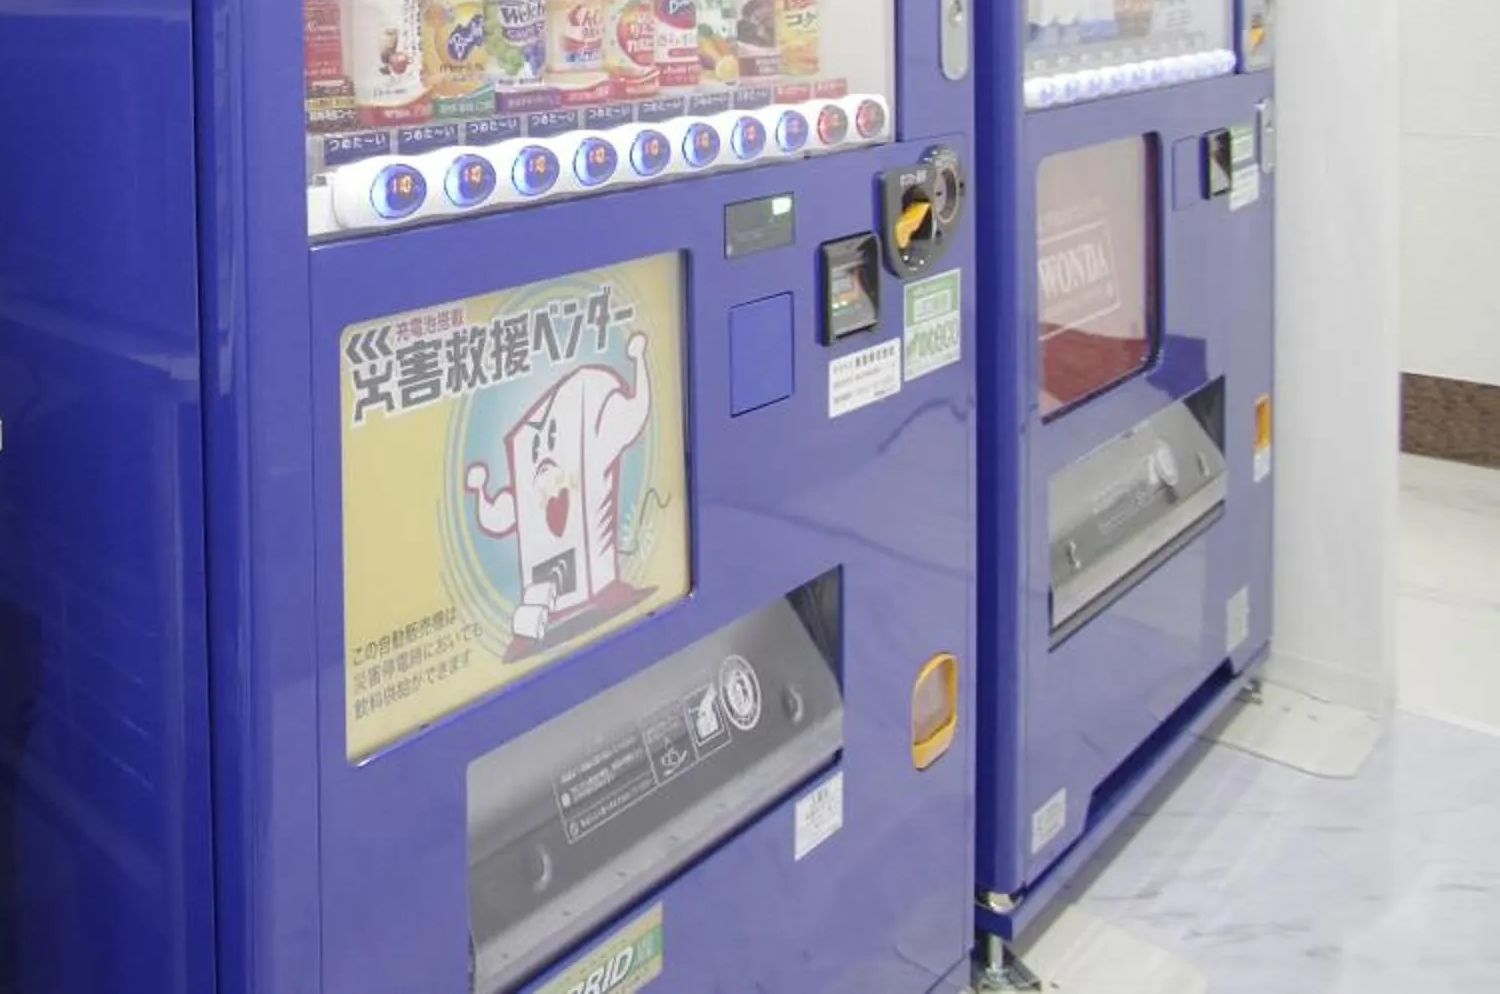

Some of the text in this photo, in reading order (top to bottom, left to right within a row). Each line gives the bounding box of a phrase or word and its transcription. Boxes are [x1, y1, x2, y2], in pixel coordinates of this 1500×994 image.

[1039, 242, 1110, 298] WONDA
[345, 285, 635, 424] 災害救援ベンダー
